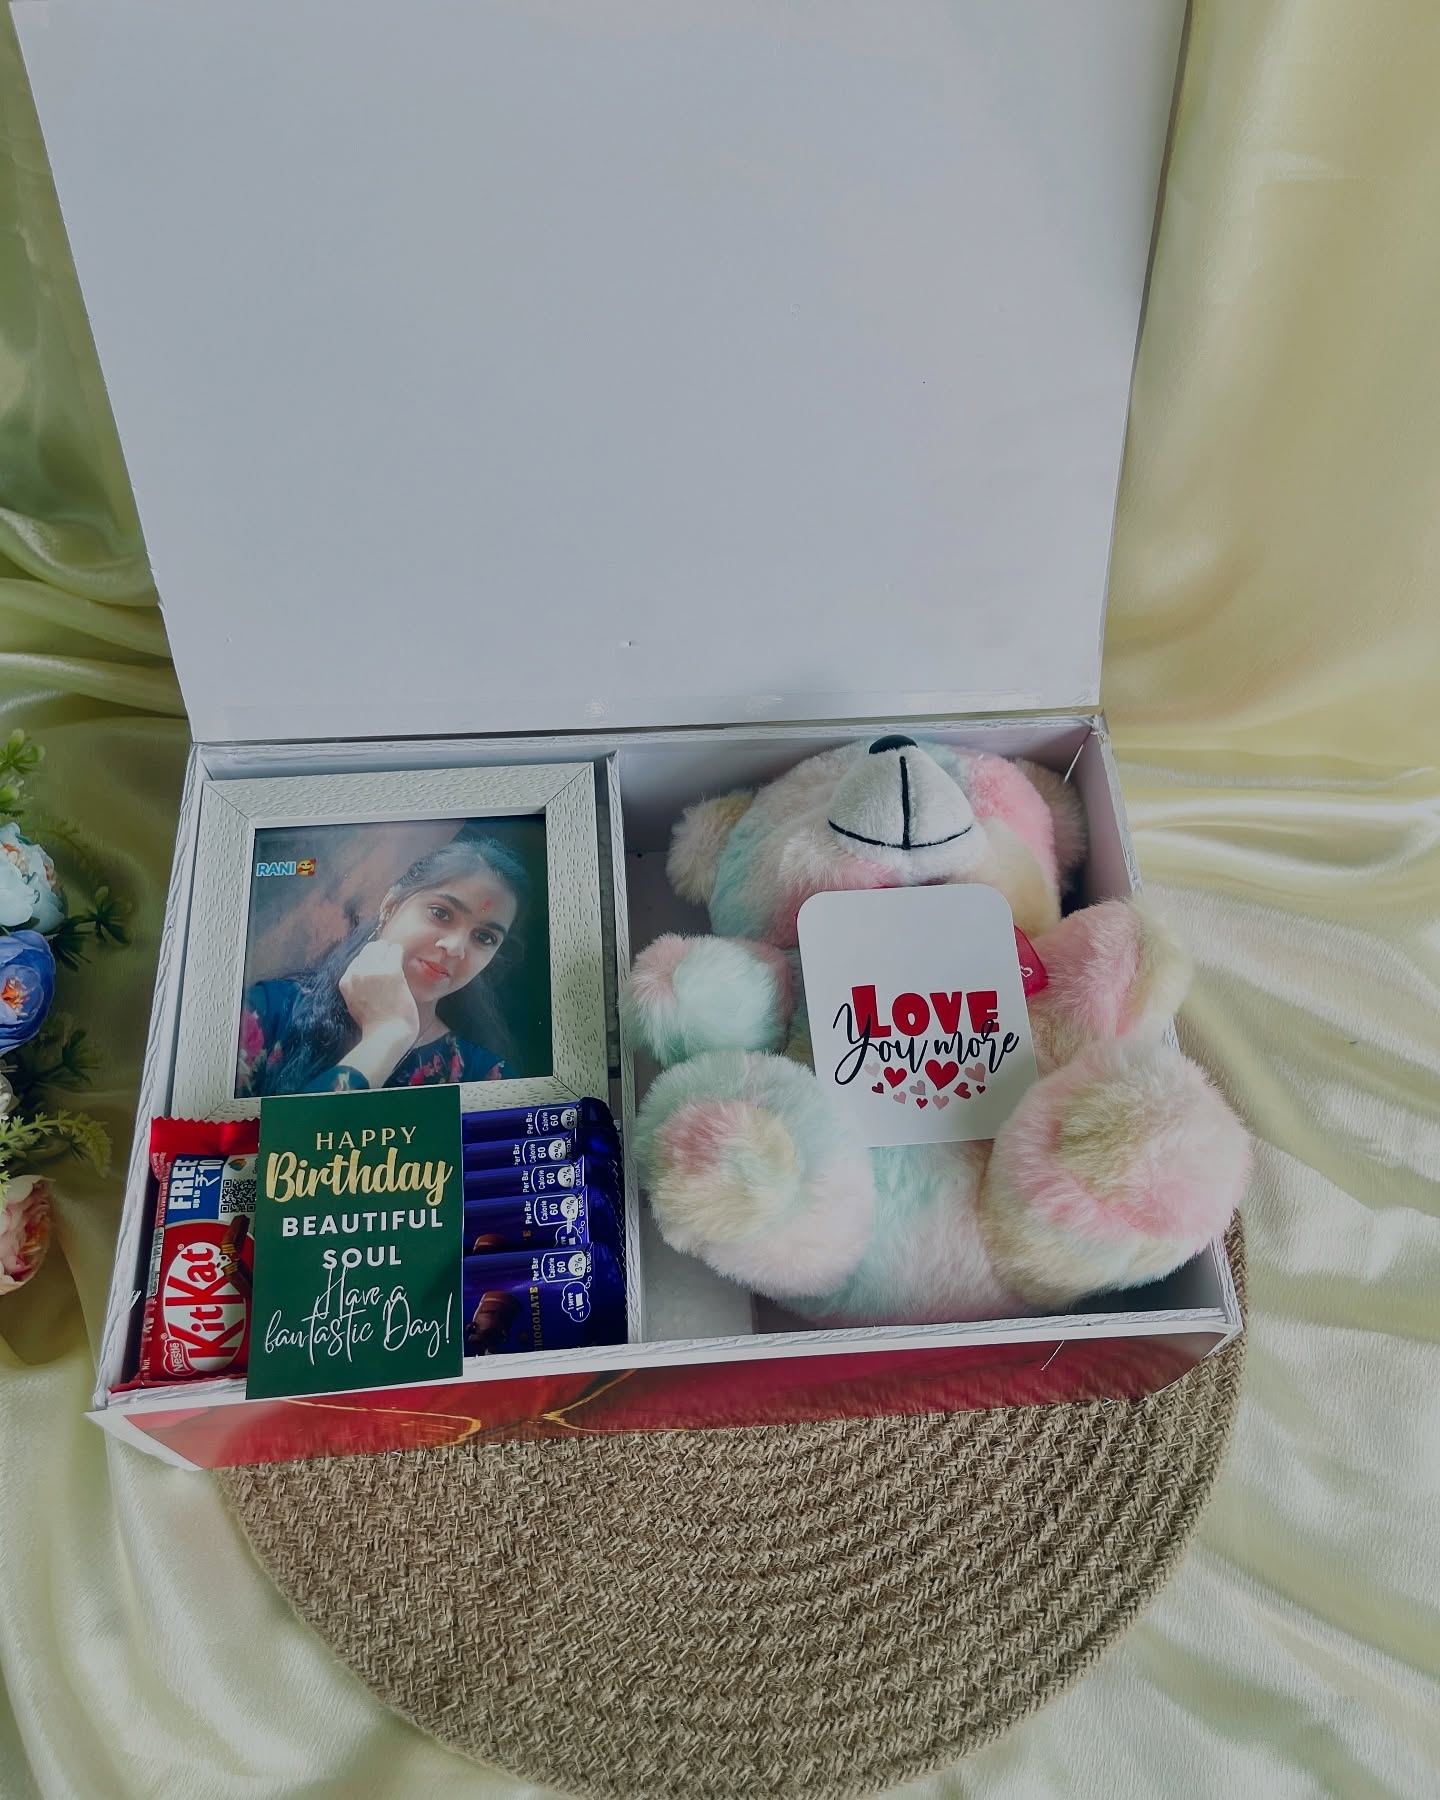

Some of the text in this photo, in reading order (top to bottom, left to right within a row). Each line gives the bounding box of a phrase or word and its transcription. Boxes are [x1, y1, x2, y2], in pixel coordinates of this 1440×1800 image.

[256, 861, 296, 876] RANI
[851, 985, 1000, 1038] LOVE
[833, 1003, 1019, 1085] You more
[550, 1115, 559, 1126] 60
[566, 1111, 575, 1127] 3%
[316, 1126, 417, 1150] HAPPY
[538, 1146, 547, 1159] 60
[169, 1159, 200, 1210] FREE
[195, 1159, 224, 1187] ₹10
[266, 1147, 453, 1206] Birthday
[547, 1172, 556, 1185] 60
[524, 1201, 532, 1212] Bar
[525, 1213, 533, 1224] Per
[549, 1203, 558, 1216] 60
[282, 1209, 443, 1237] BEAUTIFUL
[322, 1245, 402, 1270] SOUL
[531, 1257, 540, 1281] Per Bar
[557, 1261, 567, 1273] 60
[575, 1257, 583, 1273] 3%
[165, 1248, 245, 1358] KitKat
[313, 1266, 406, 1321] Have a
[265, 1292, 453, 1365] fantastic Day!
